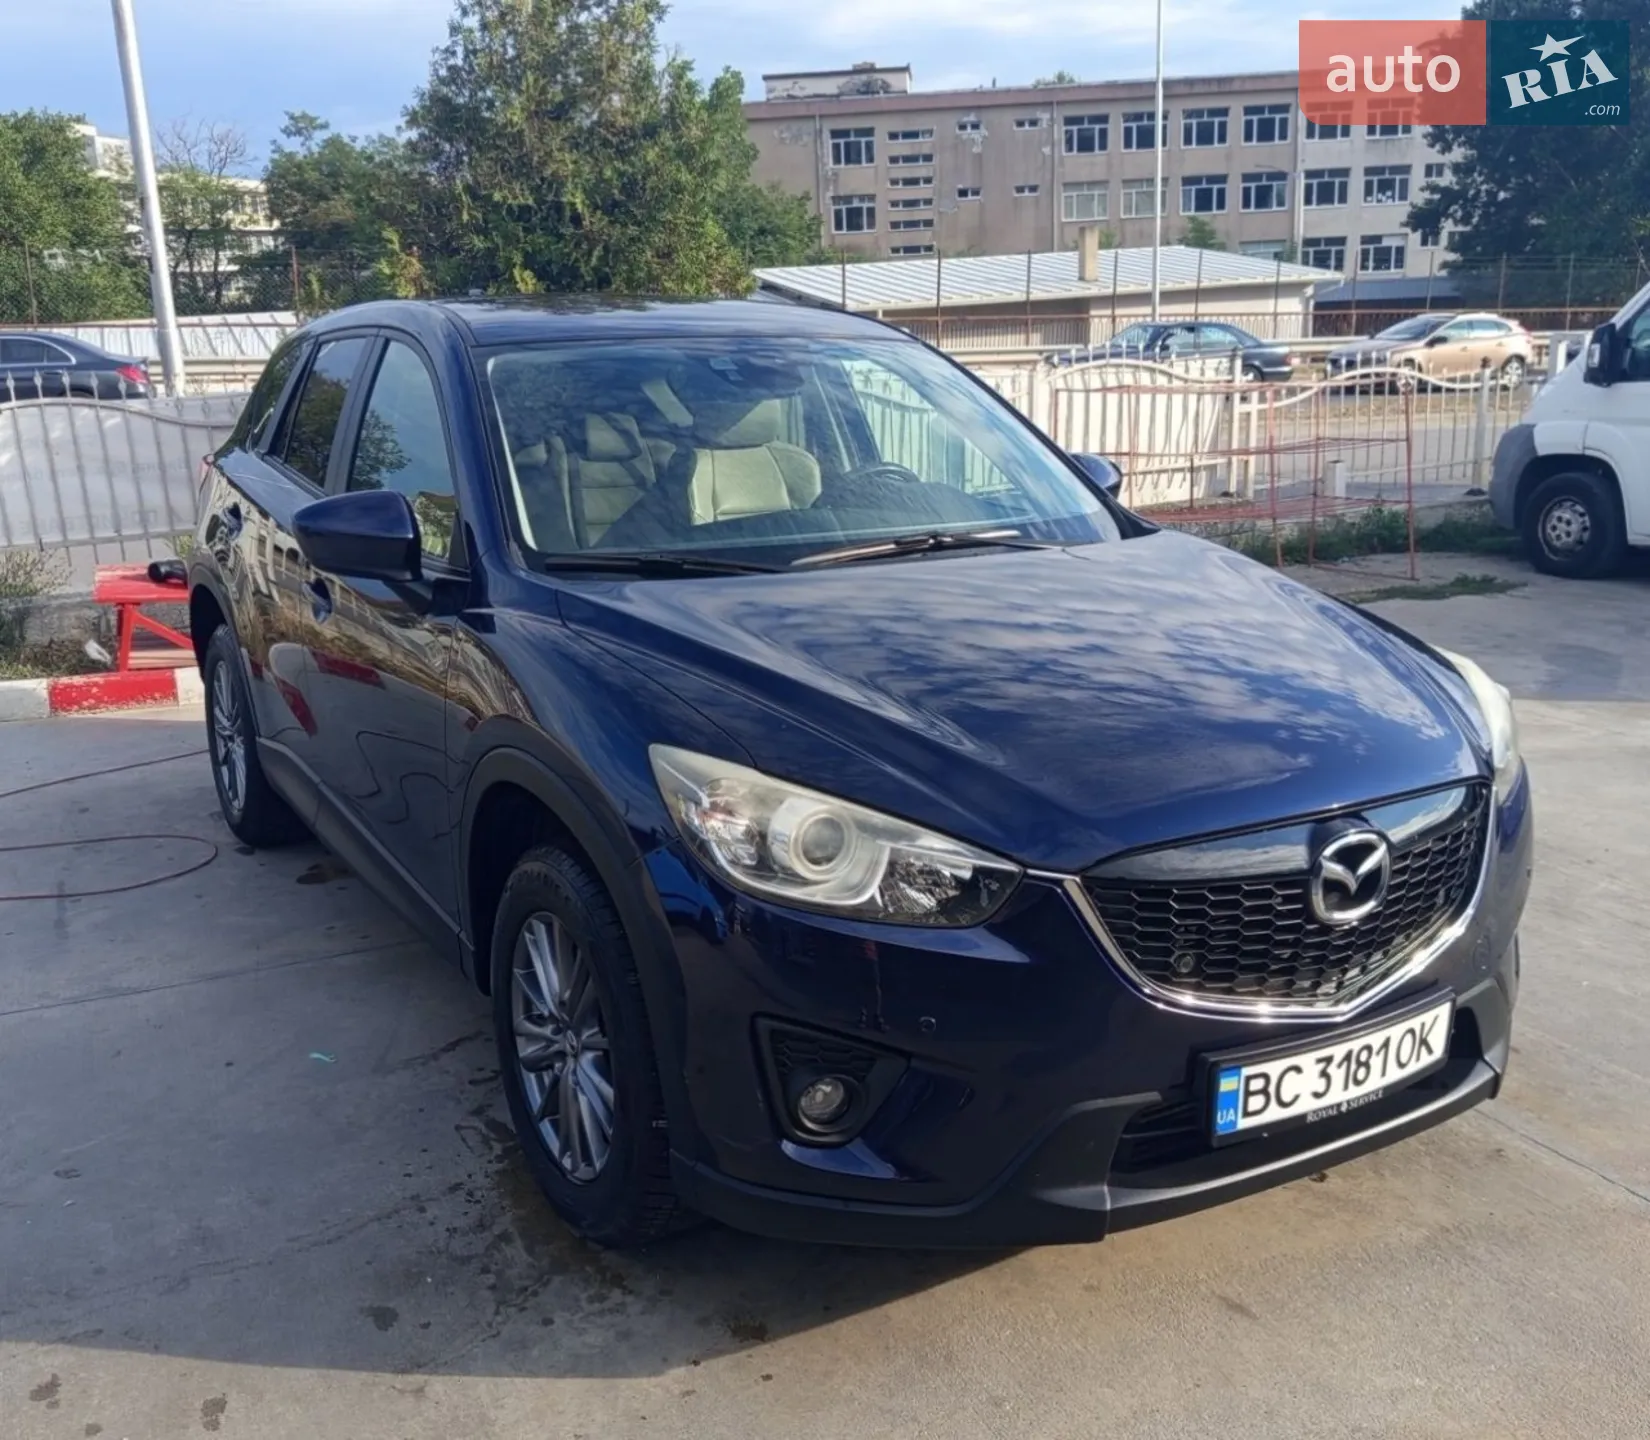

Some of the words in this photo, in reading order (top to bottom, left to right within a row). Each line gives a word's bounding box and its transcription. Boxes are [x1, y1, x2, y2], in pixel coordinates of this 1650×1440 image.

[1241, 1064, 1304, 1120] BC
[1311, 1035, 1392, 1100] 3181
[1395, 1014, 1440, 1071] OK
[1217, 1108, 1236, 1125] UA
